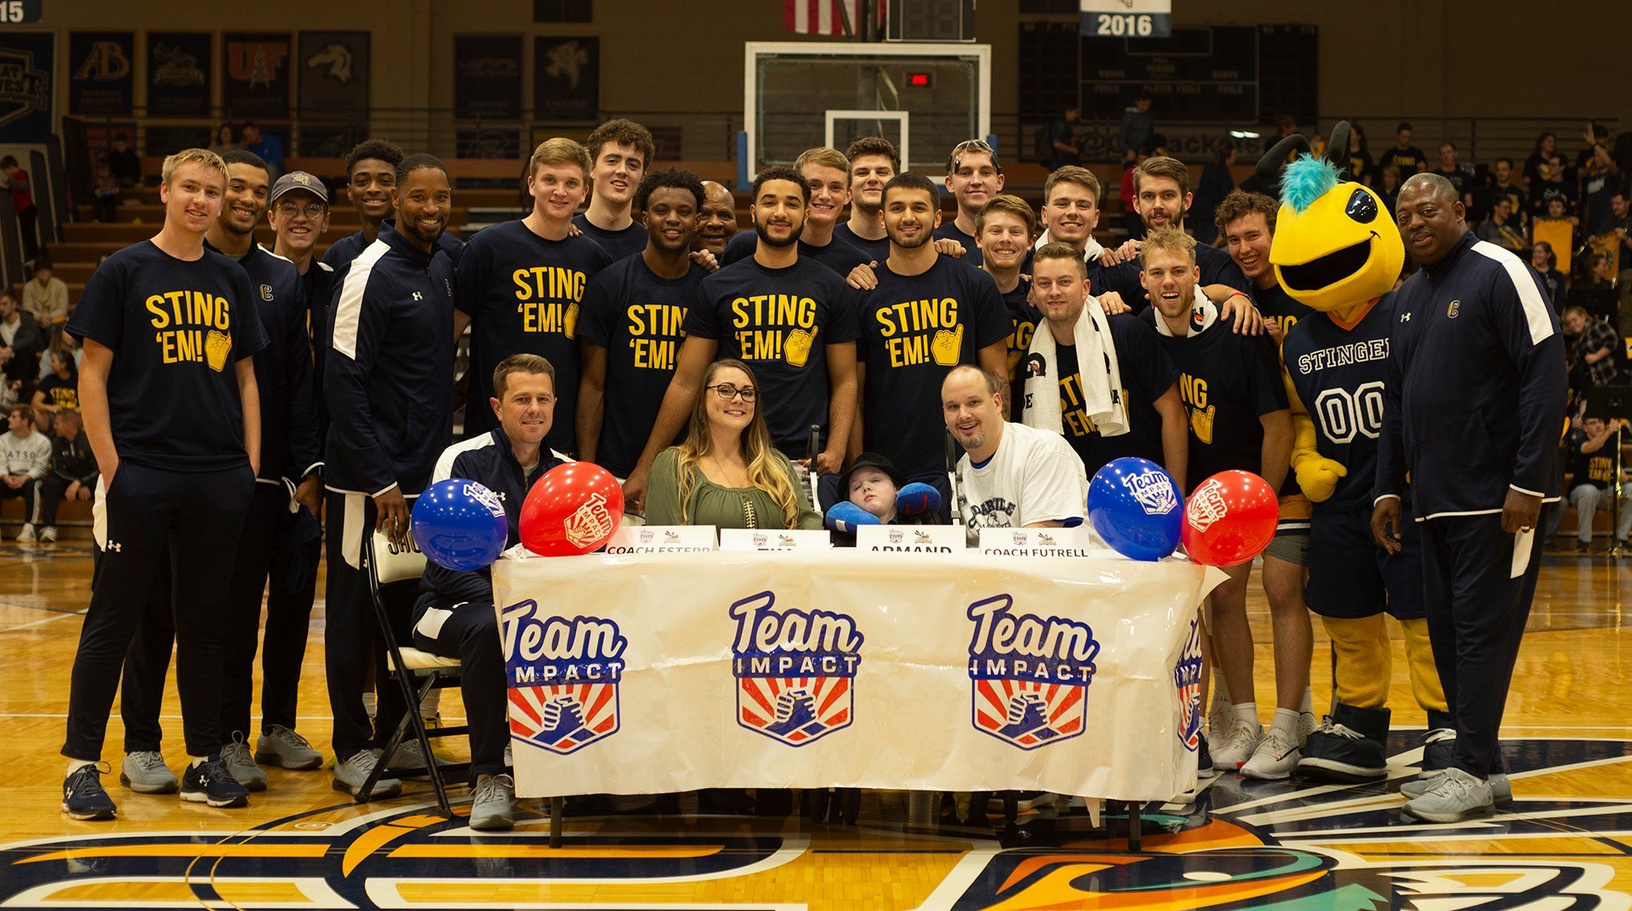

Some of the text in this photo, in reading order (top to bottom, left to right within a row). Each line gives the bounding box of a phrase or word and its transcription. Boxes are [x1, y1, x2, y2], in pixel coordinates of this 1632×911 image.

[1097, 14, 1153, 36] 2016
[513, 267, 586, 303] STING
[146, 290, 230, 330] STING
[626, 304, 689, 338] STIN
[732, 294, 817, 329] STING
[876, 298, 958, 337] STING
[1315, 381, 1385, 444] 00
[1124, 473, 1168, 494] Team
[585, 493, 613, 535] Team
[607, 546, 654, 555] COACH
[984, 548, 1089, 559] COACH FUTRELL
[502, 603, 623, 663] Team
[734, 595, 859, 654] Team
[972, 598, 1095, 662] Team
[515, 663, 623, 683] MPACT
[737, 656, 858, 674] IMPACT
[971, 659, 1091, 682] IMPACT
